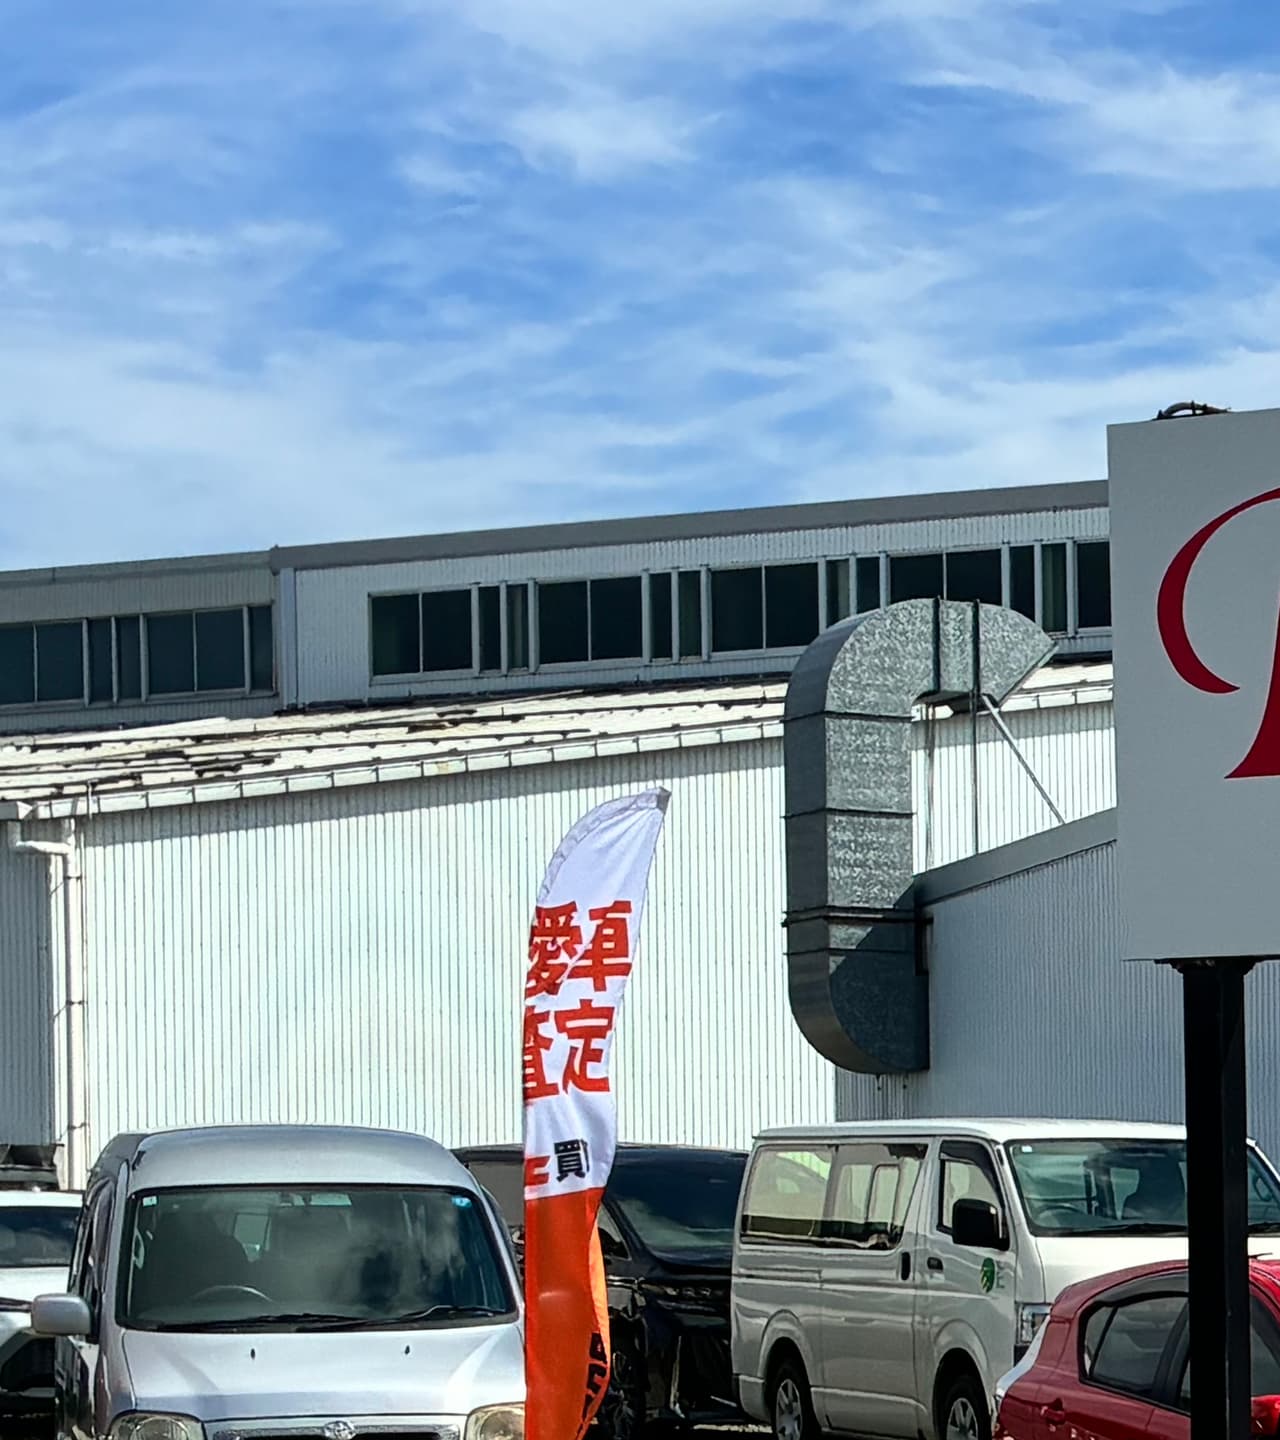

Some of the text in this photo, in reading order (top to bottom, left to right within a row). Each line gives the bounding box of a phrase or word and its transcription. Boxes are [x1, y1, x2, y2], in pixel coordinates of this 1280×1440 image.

[524, 899, 633, 998] 愛車
[522, 998, 616, 1106] 査定
[554, 1138, 590, 1183] 買
